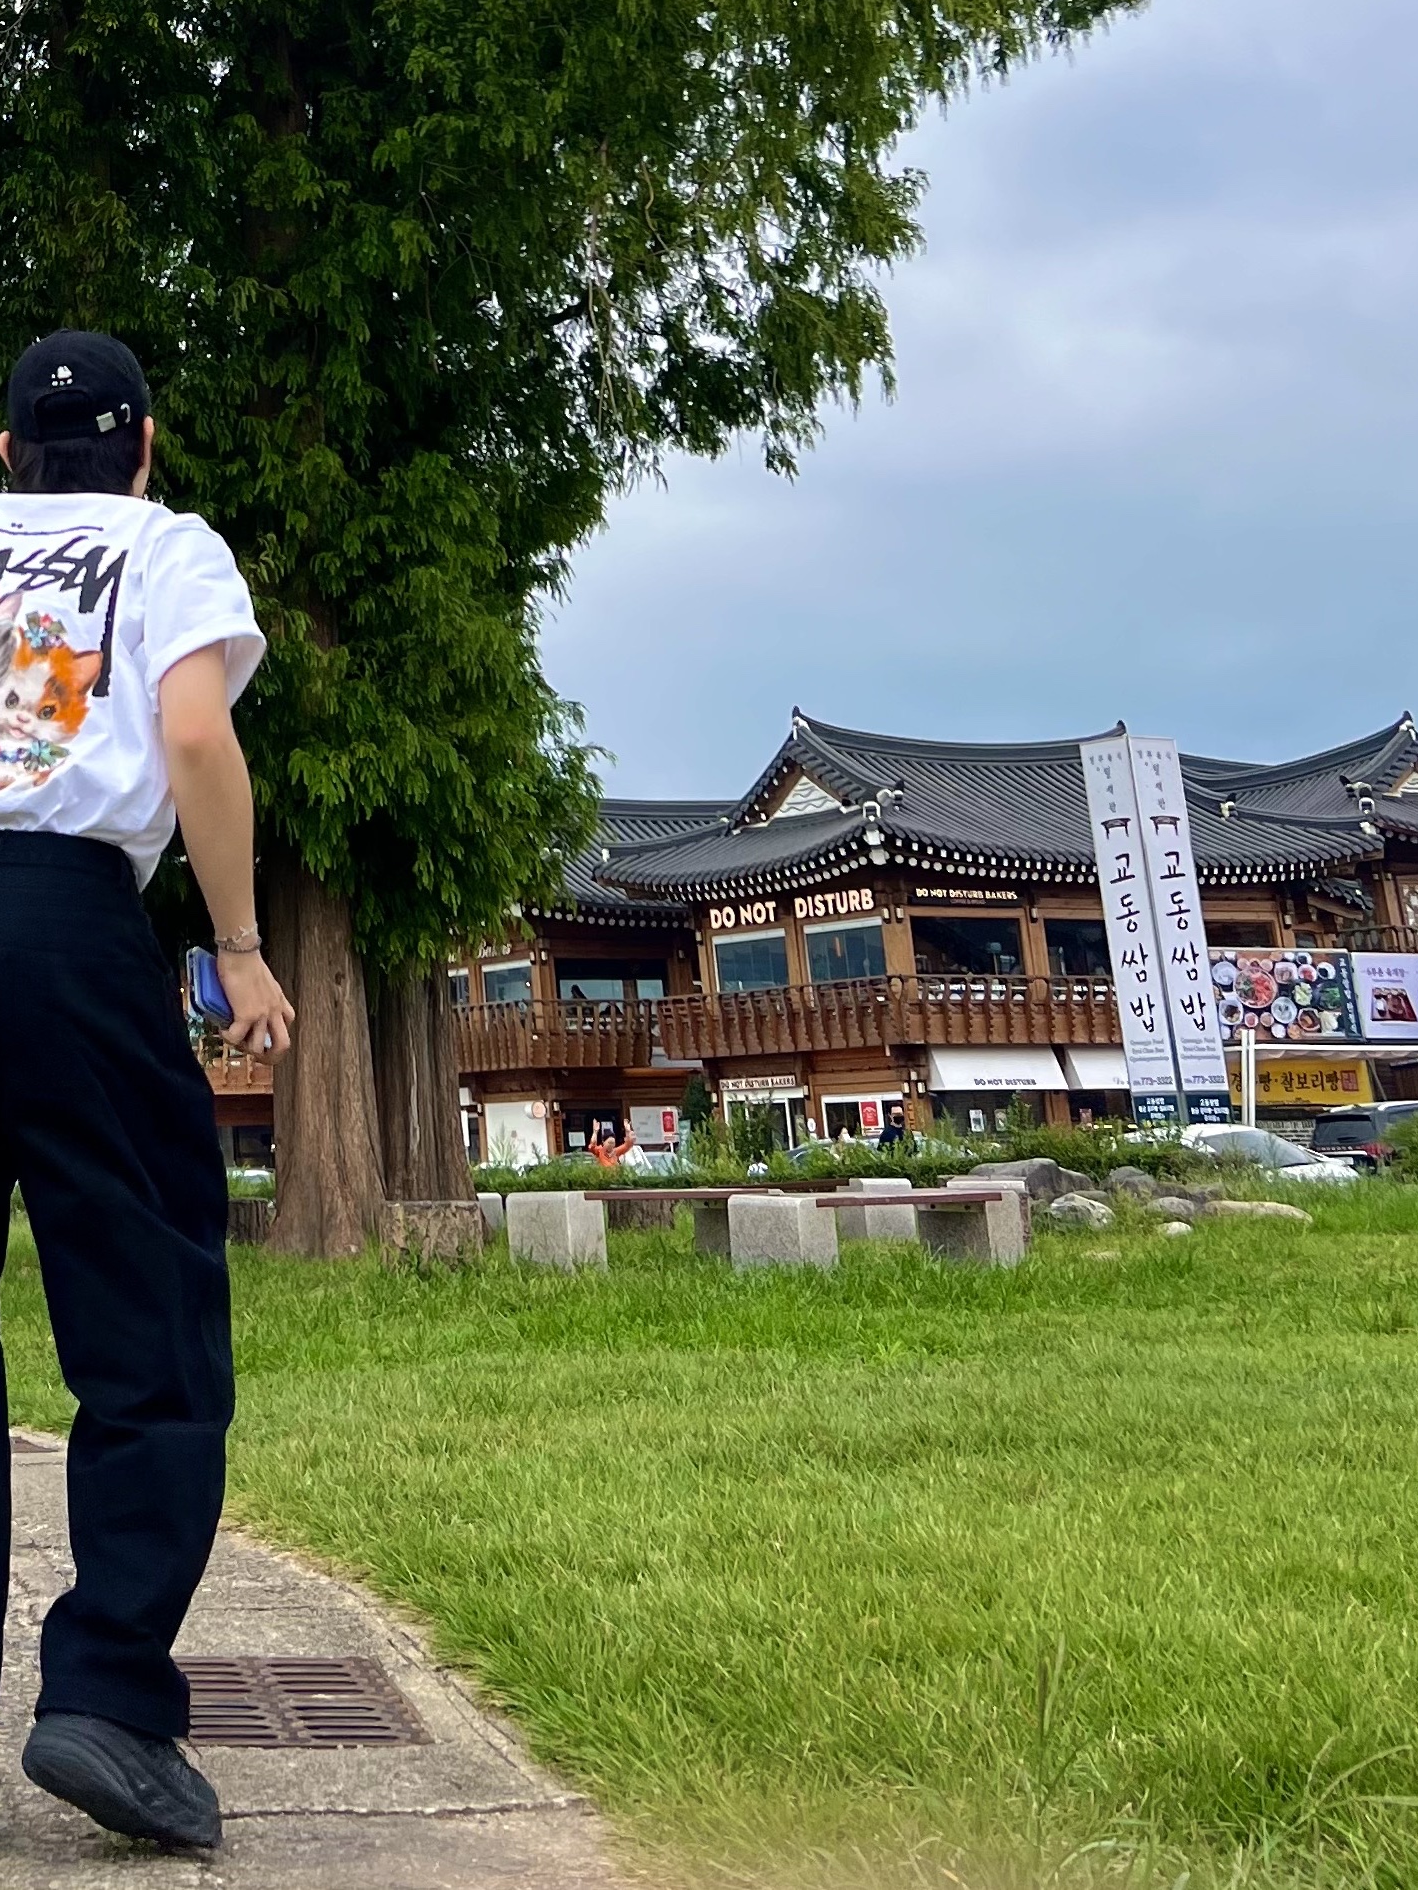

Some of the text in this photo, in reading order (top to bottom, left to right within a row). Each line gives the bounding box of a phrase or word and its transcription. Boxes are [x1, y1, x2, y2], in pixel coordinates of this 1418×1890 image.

[710, 888, 875, 929] DO NOT DISTURB
[915, 888, 1018, 900] DO NOT DISTURB BAKERS
[1110, 853, 1156, 1033] 교동쌈밥
[1159, 851, 1207, 1031] 교동쌈밥
[974, 1078, 1037, 1086] DO NOT DISTURB
